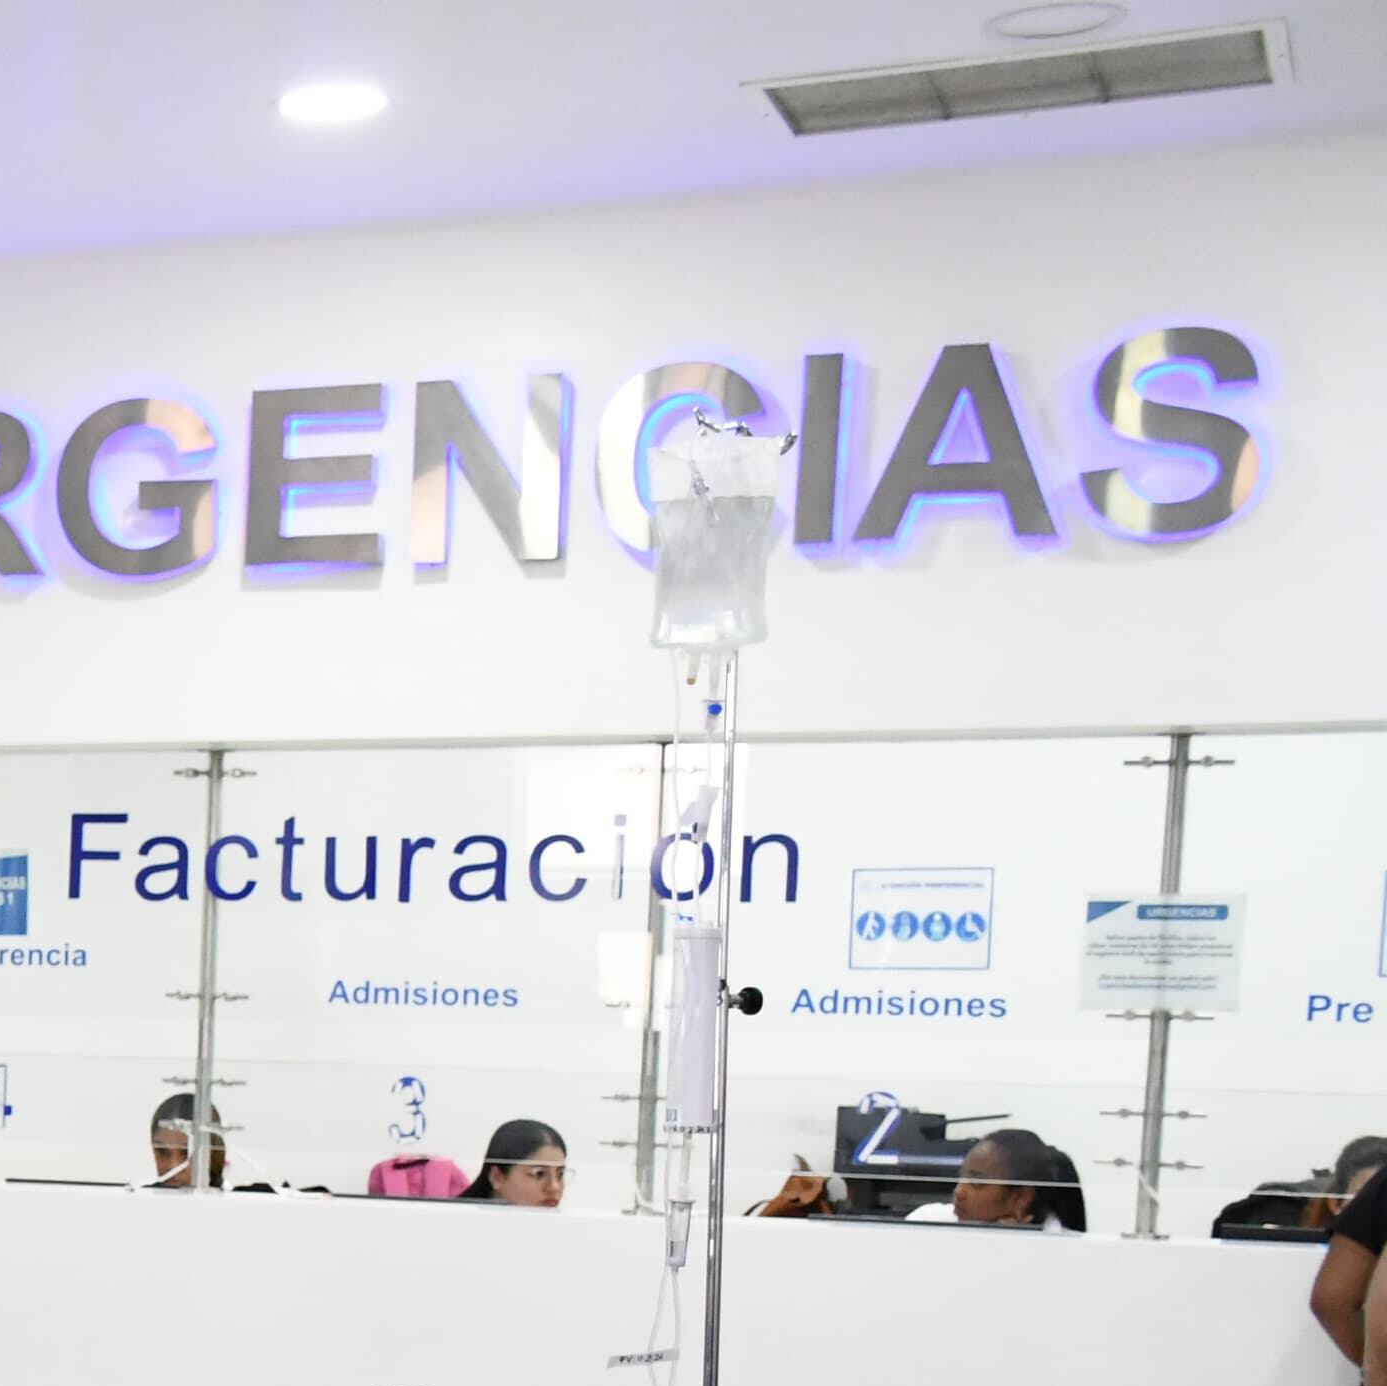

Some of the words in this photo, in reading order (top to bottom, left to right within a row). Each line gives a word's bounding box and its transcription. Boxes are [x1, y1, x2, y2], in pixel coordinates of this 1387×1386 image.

[68, 806, 802, 905] Facturación
[329, 981, 520, 1008] Admisiones
[793, 989, 1007, 1019] Admisiones
[1307, 994, 1374, 1024] Pre
[388, 1075, 427, 1143] 3
[851, 1090, 900, 1165] 2
